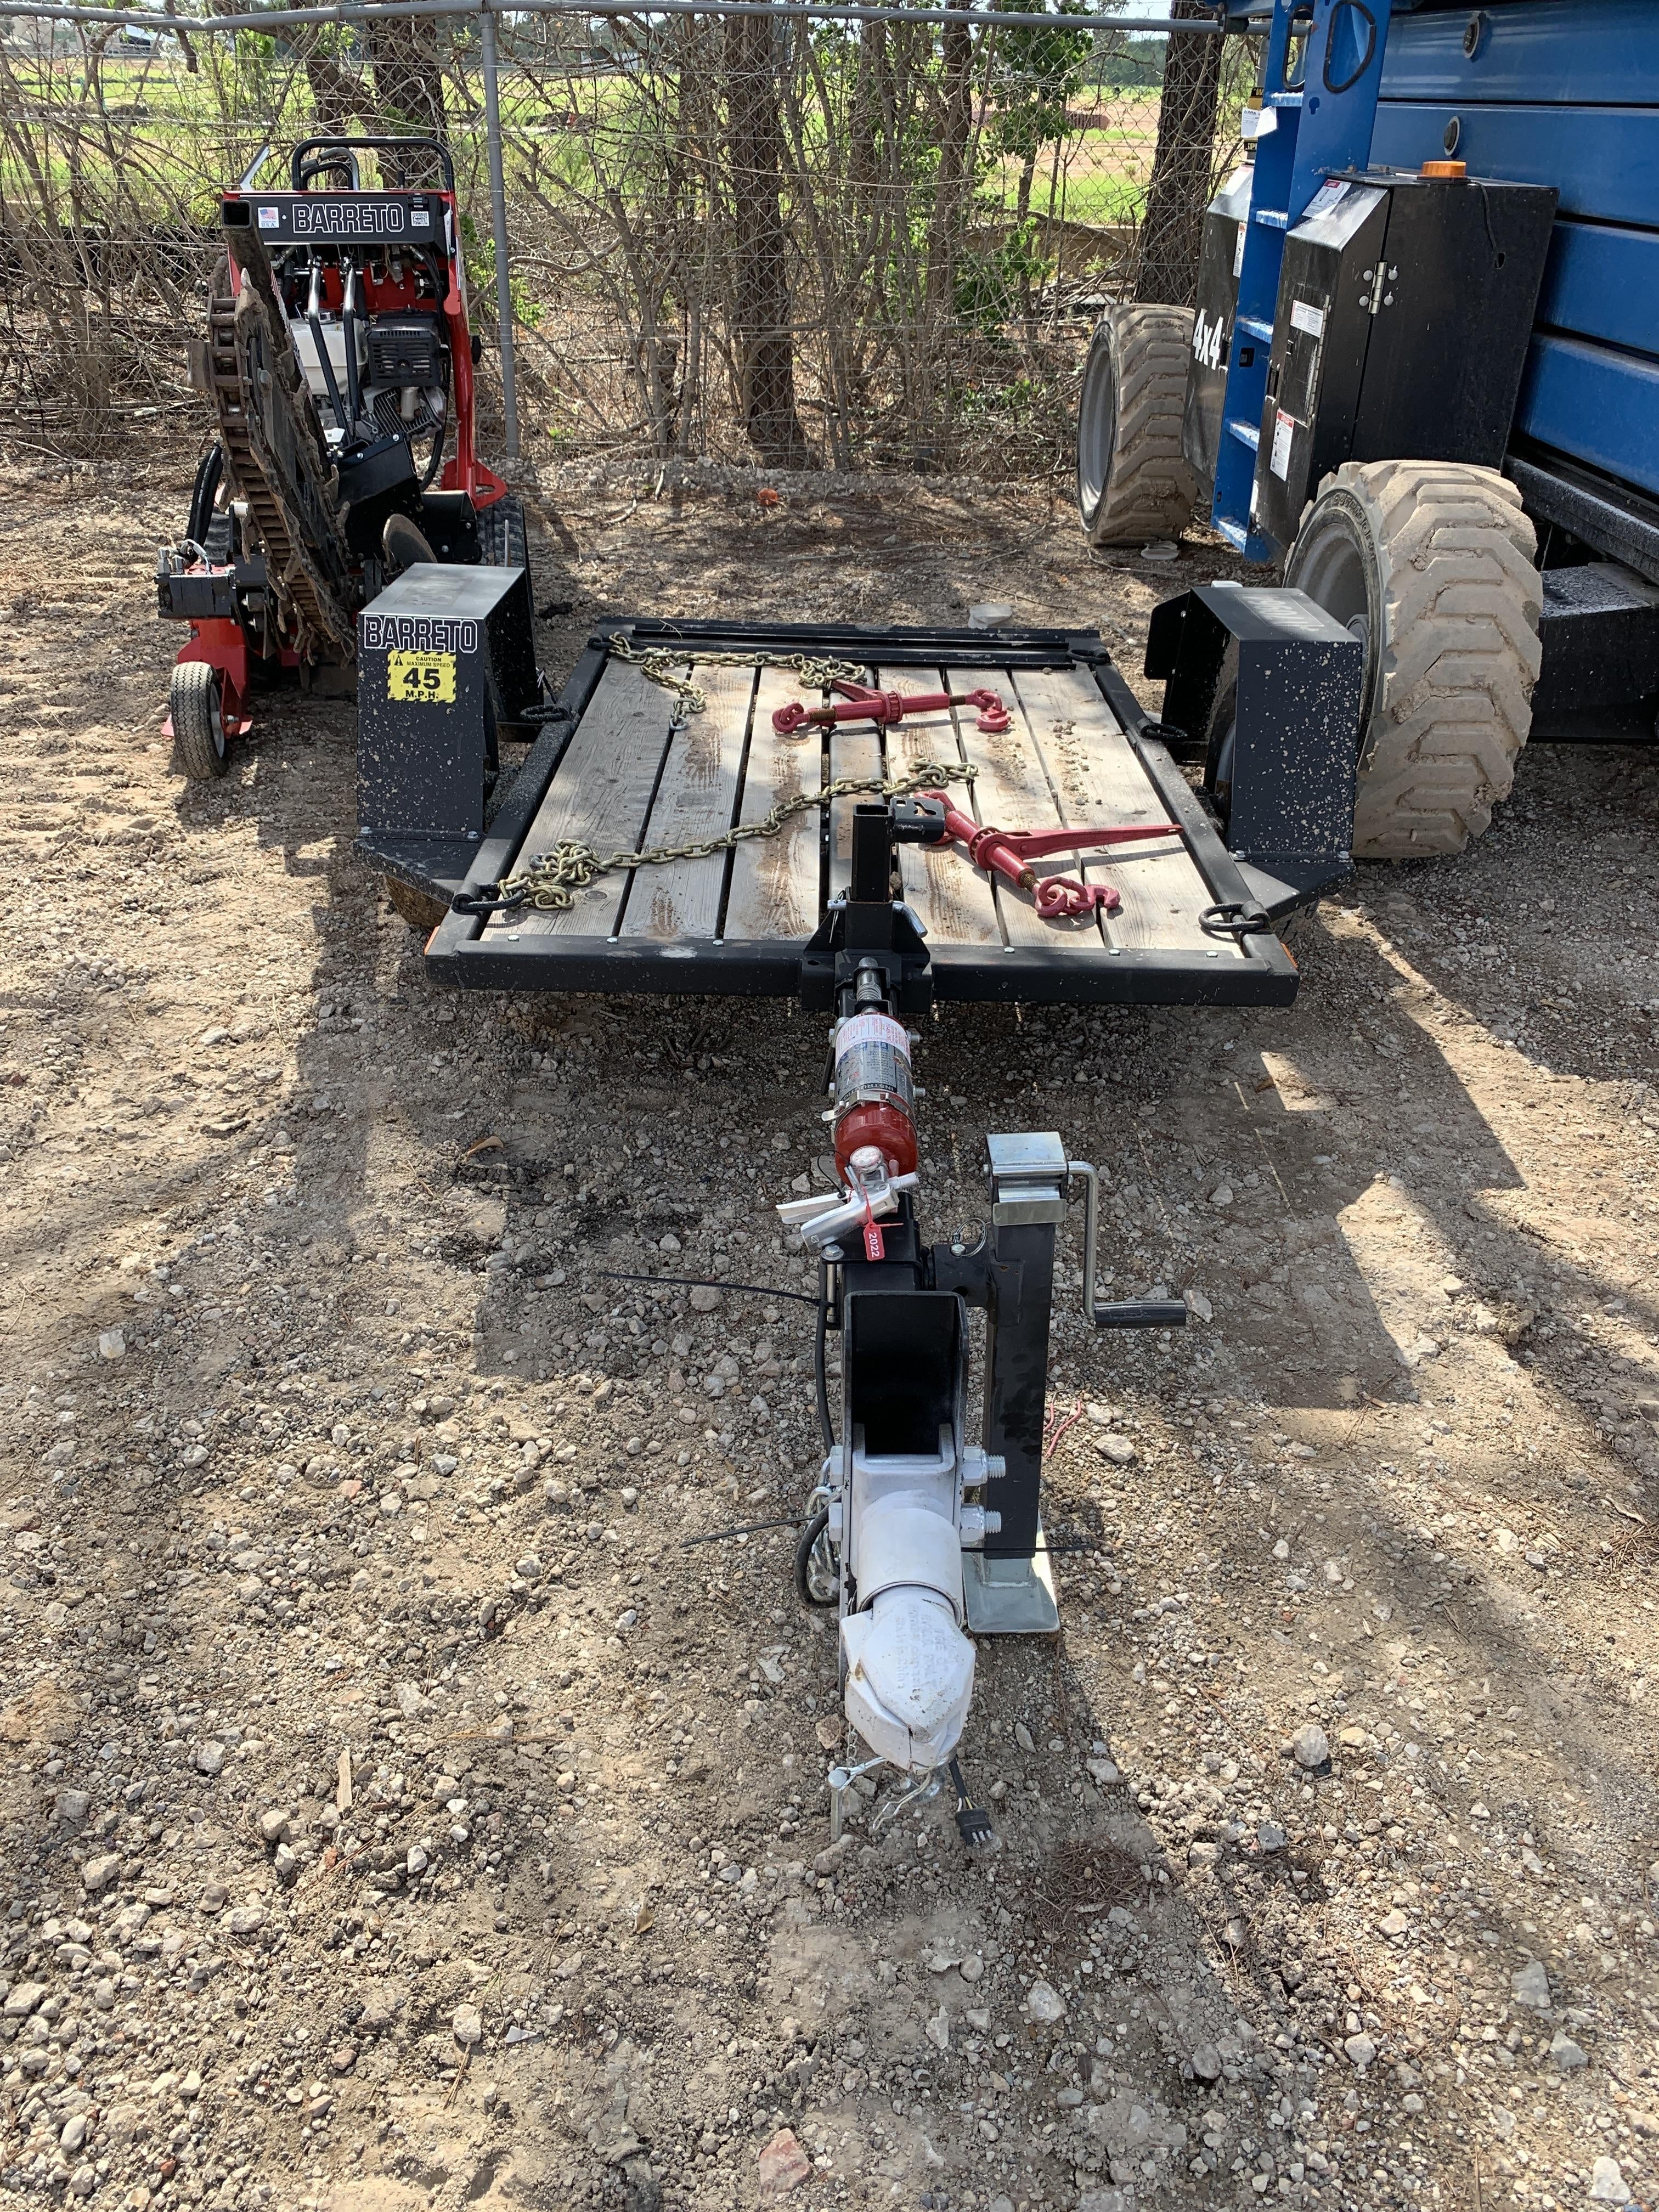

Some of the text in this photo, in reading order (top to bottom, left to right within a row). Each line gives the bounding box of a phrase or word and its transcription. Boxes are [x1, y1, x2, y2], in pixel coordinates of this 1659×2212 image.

[292, 203, 404, 233] BARRETO
[364, 614, 477, 653] BARRETO
[403, 667, 441, 690] 45
[405, 690, 438, 699] M.P.H.
[868, 1232, 880, 1258] 2022
